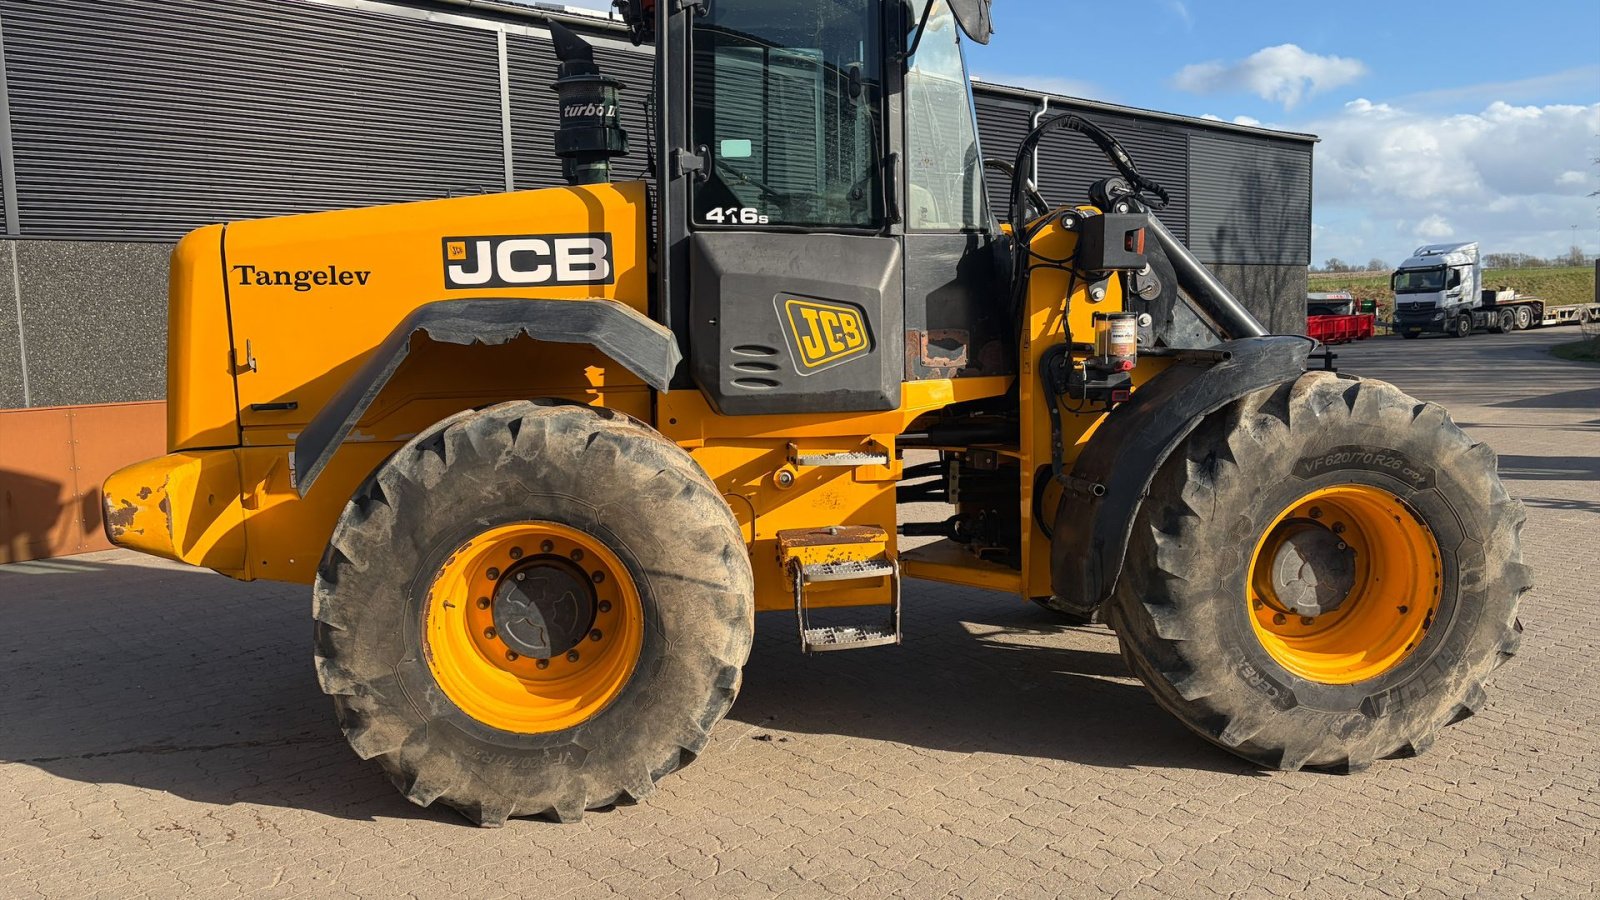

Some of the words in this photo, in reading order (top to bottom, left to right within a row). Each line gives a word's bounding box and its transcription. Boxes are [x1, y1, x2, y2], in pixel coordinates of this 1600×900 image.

[230, 265, 371, 292] Tangelev
[448, 237, 610, 285] JCB
[800, 307, 862, 359] JCB
[1304, 458, 1323, 473] VF
[1325, 452, 1373, 466] 620/70
[1372, 454, 1402, 469] R26
